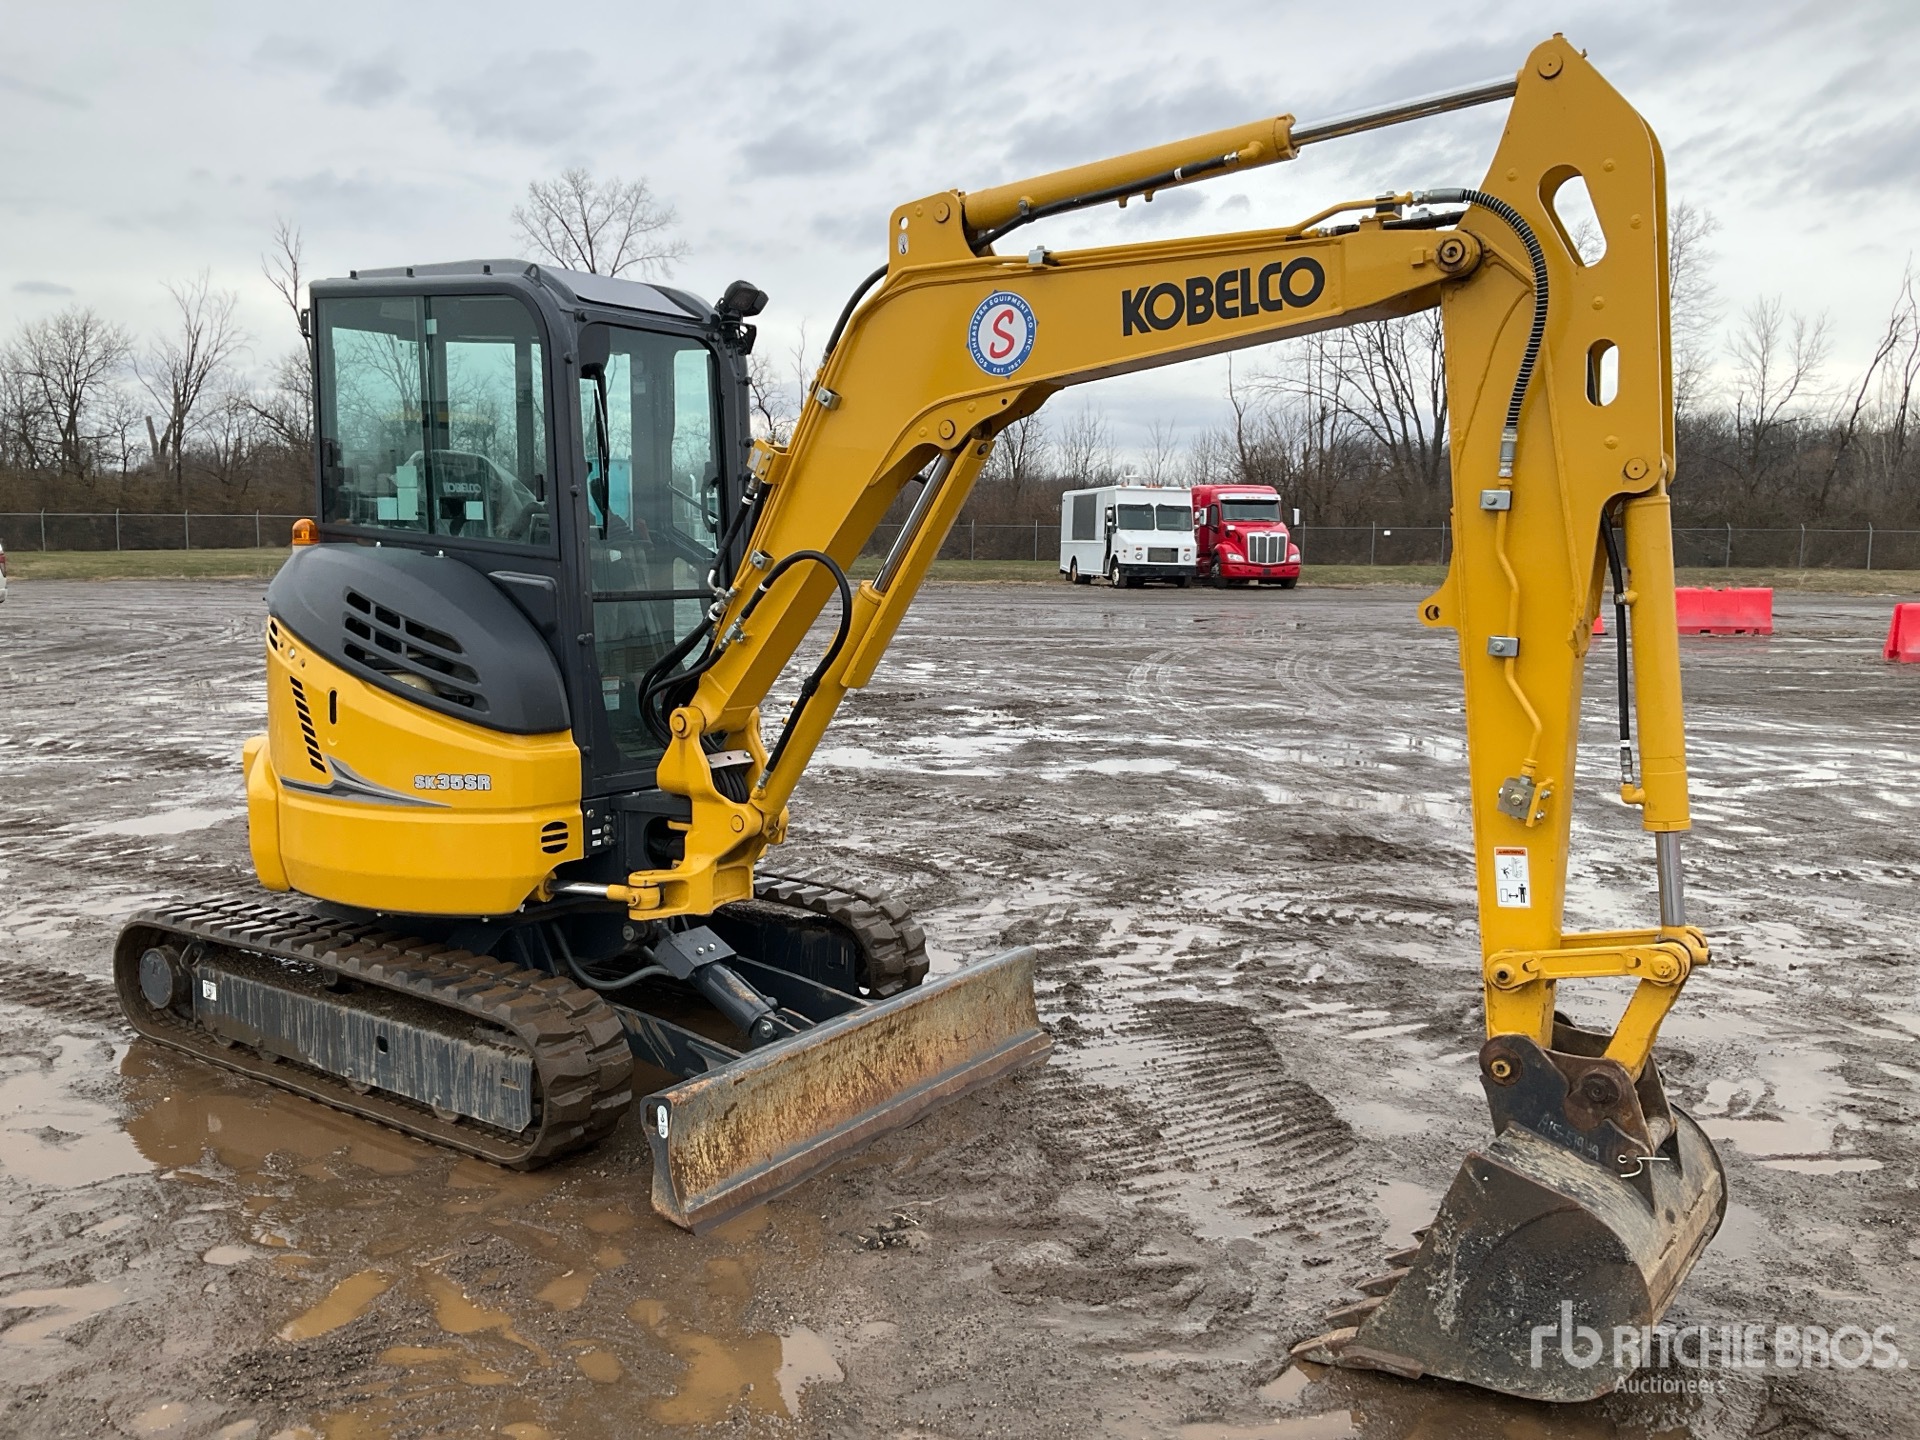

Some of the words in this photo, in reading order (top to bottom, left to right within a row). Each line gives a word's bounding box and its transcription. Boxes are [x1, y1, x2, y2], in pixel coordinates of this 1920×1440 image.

[1122, 256, 1326, 337] KOBELCO
[970, 305, 989, 368] SOUTHEASTERN
[989, 295, 1029, 314] EQUIPMENT
[989, 309, 1015, 359] S
[1008, 358, 1022, 371] 1957
[413, 773, 492, 791] SK35SR
